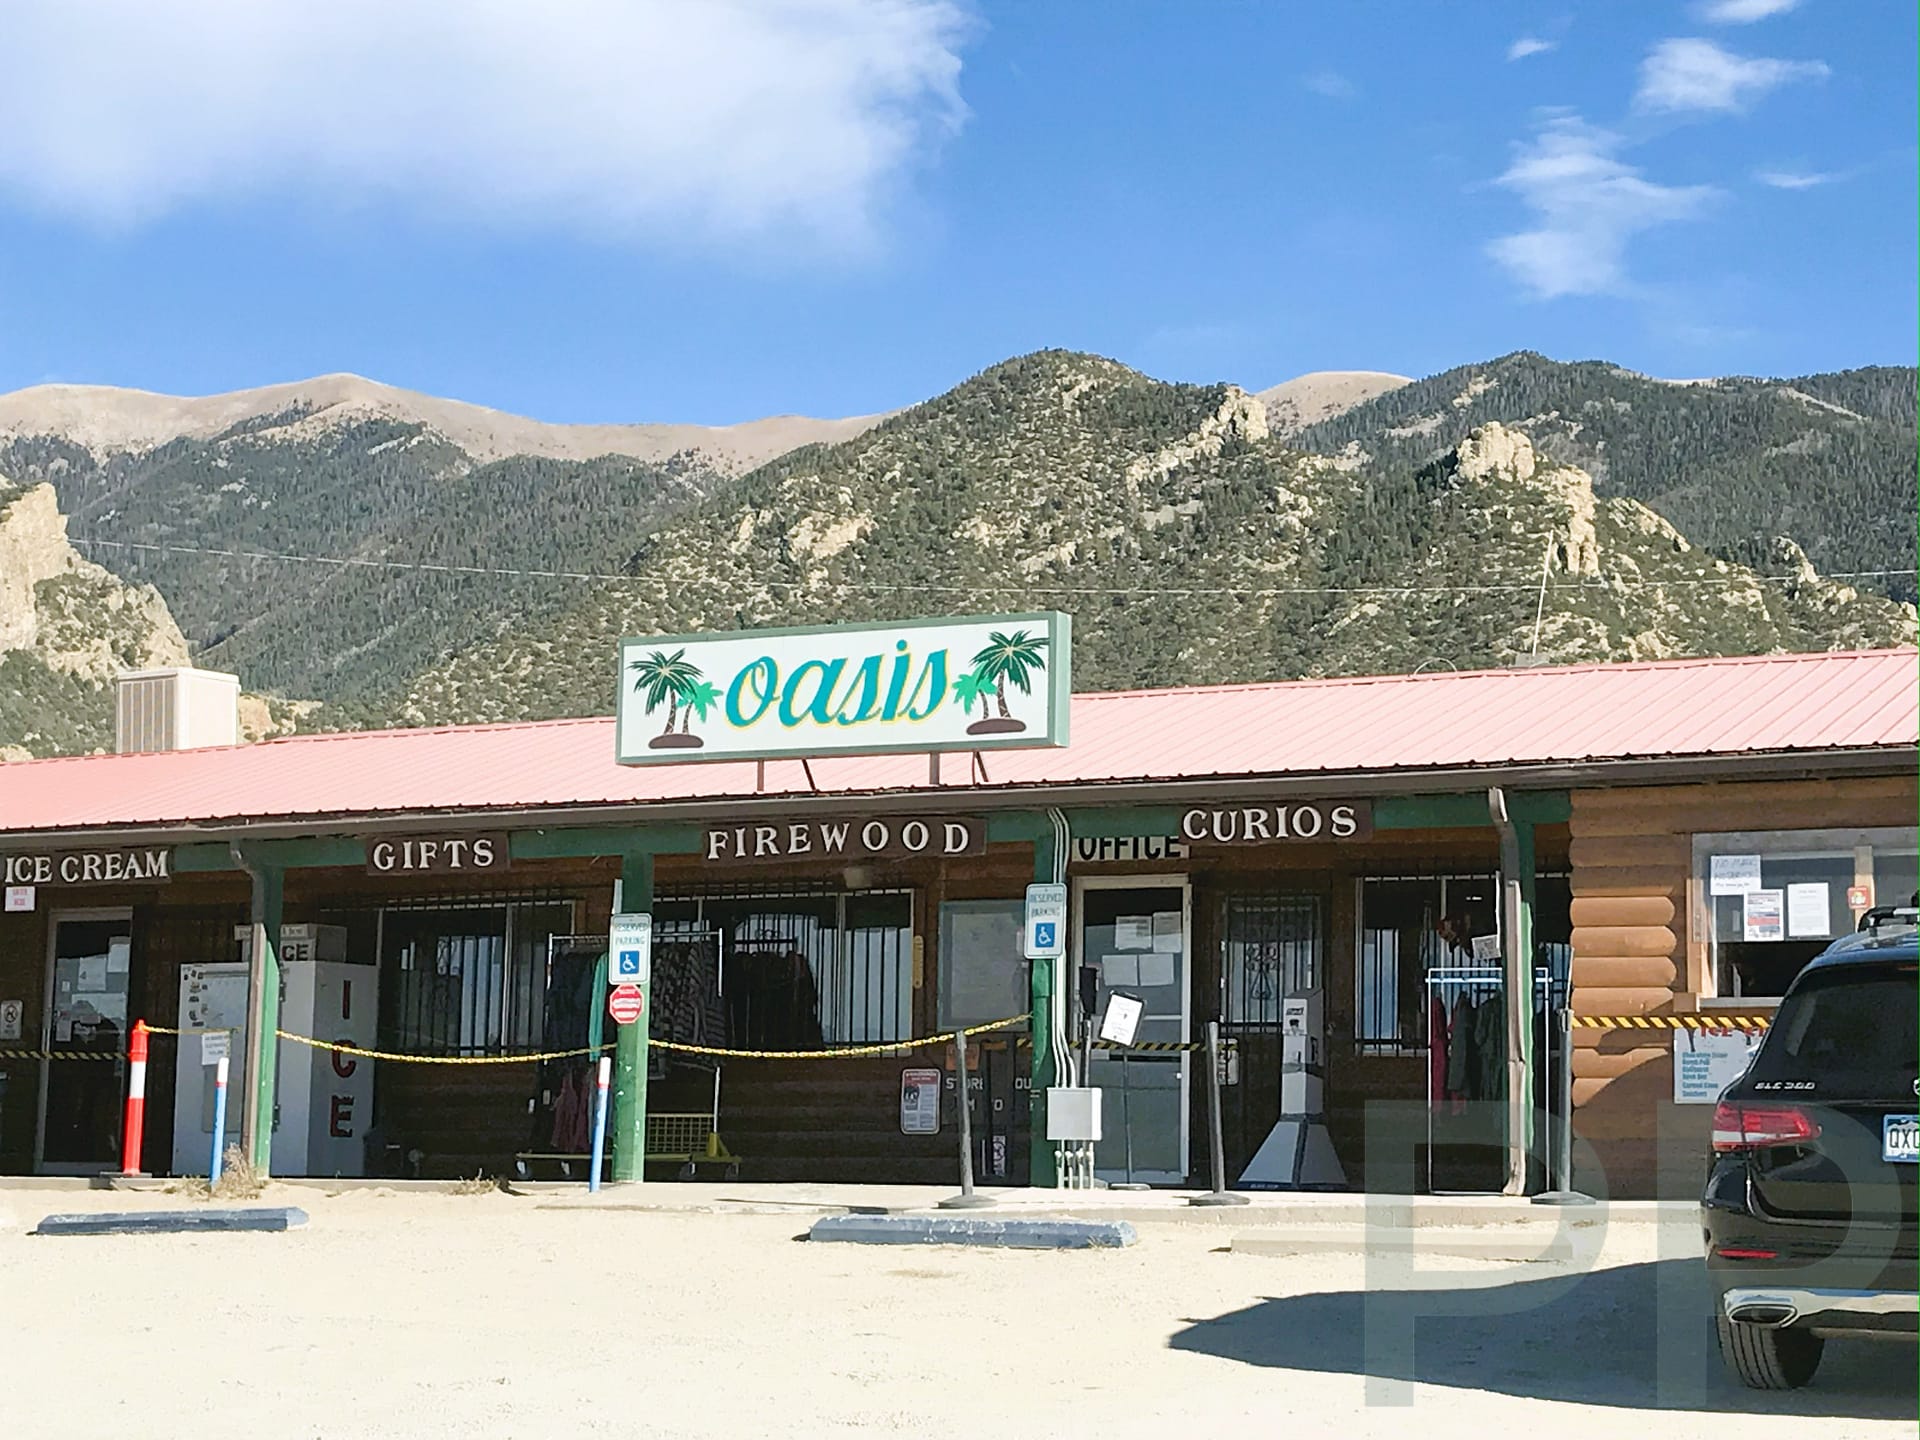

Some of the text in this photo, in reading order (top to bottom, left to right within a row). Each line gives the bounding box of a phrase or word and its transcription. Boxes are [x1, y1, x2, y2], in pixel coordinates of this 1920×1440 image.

[724, 639, 949, 730] oasis
[708, 821, 969, 860] FIREWOOD
[1182, 806, 1357, 842] CURIOS
[373, 839, 494, 871] GIFTS
[1079, 835, 1182, 860] OFFICE
[5, 850, 169, 883] ICE CREAM
